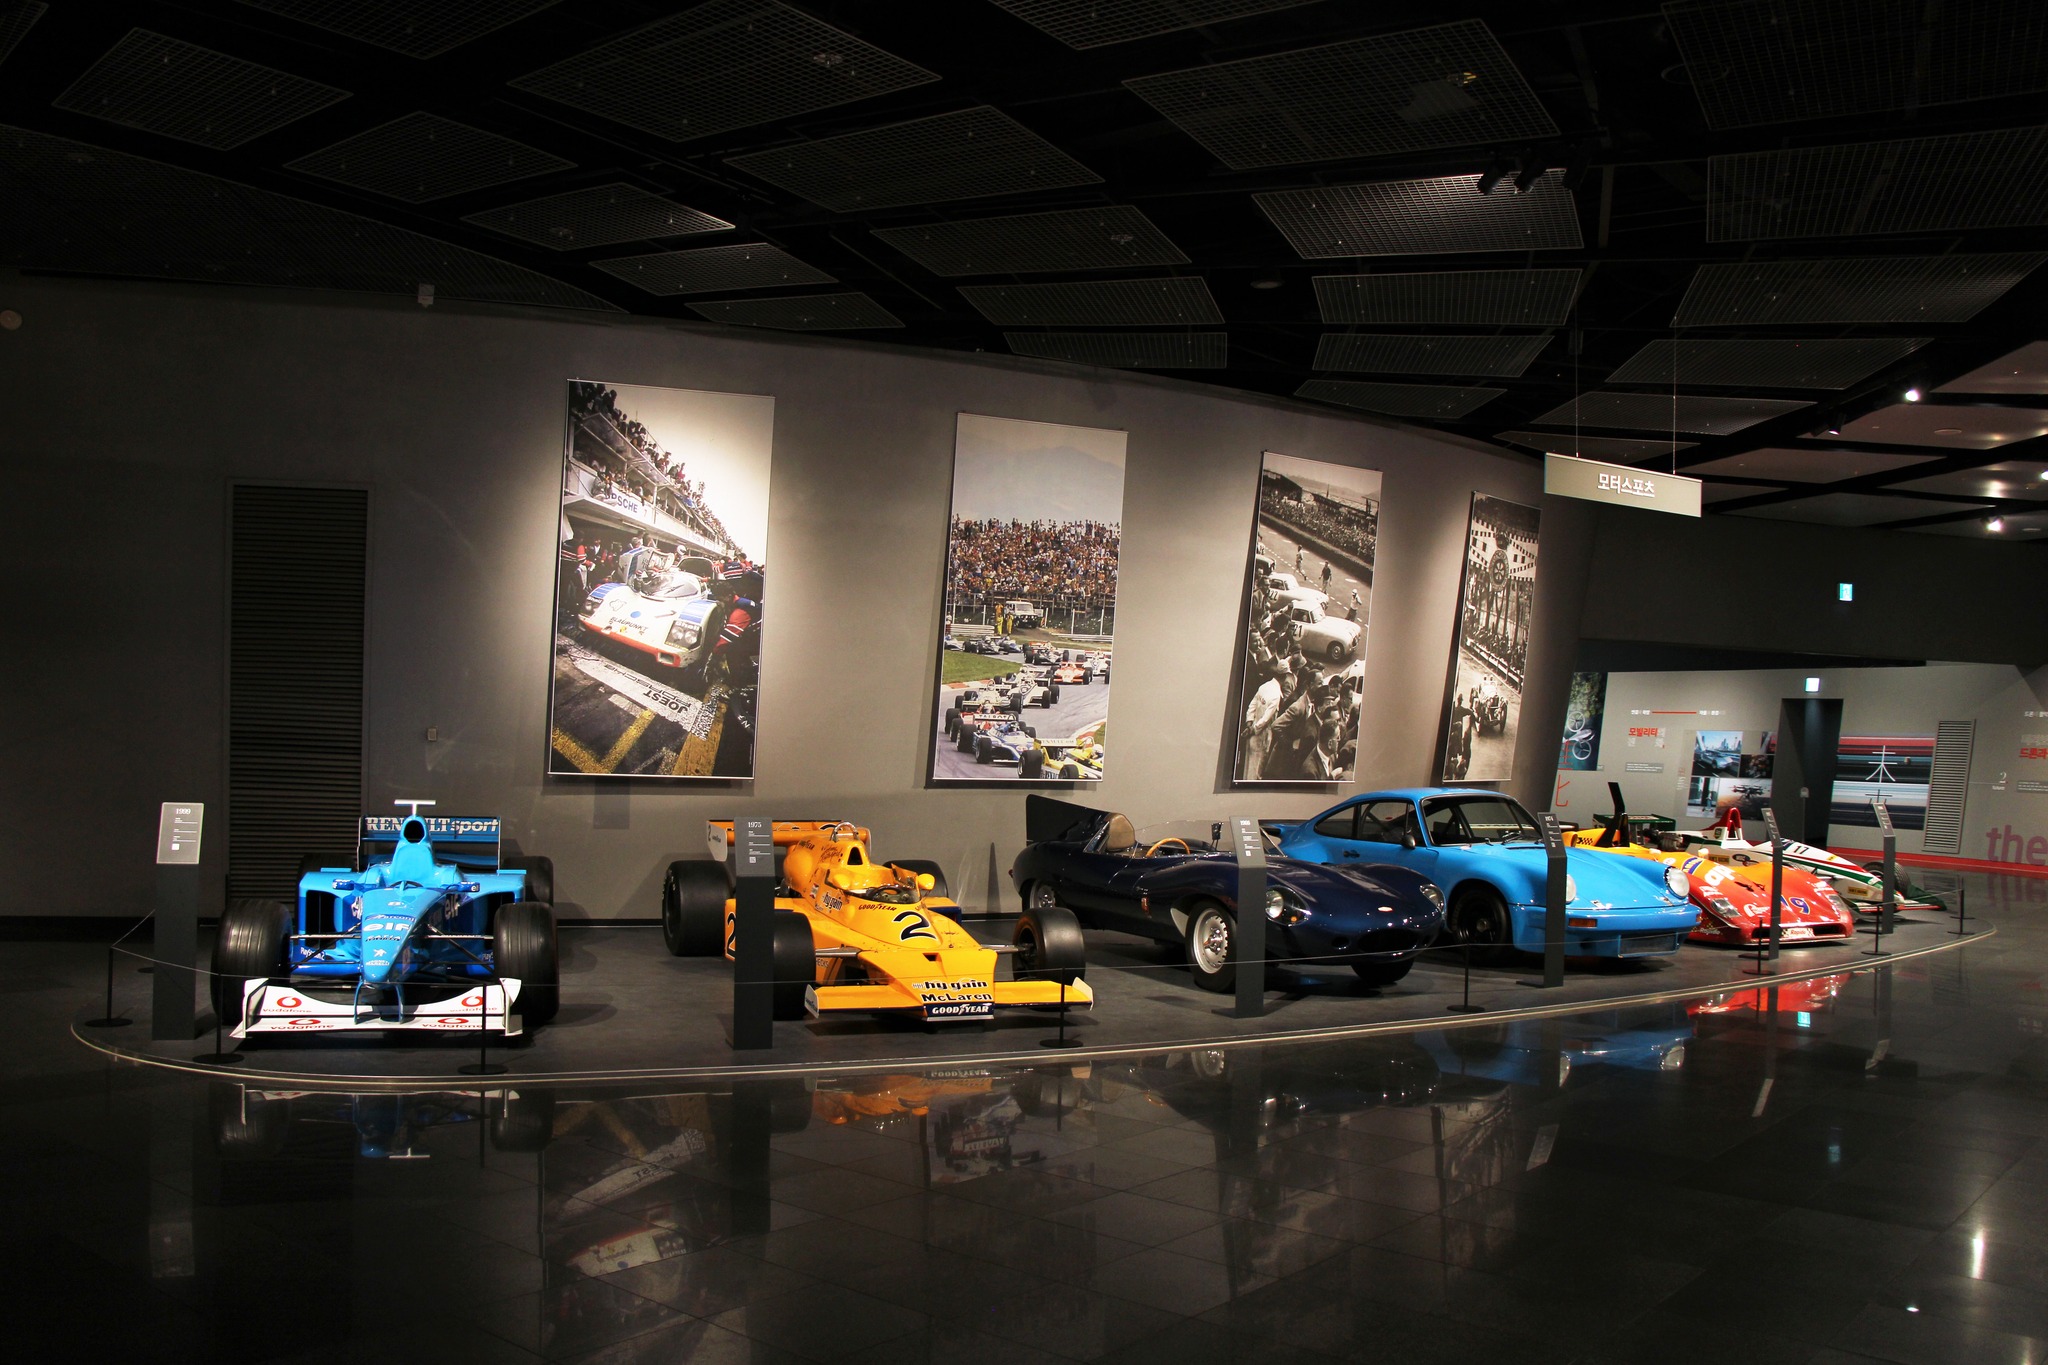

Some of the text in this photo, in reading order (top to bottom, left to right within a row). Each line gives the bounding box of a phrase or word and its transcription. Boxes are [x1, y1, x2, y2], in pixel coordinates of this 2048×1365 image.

[1597, 472, 1656, 498] 모터스포츠
[609, 616, 649, 632] BLAUPUNKT
[643, 690, 689, 714] JOEST
[365, 817, 499, 835] RENLT sport
[1794, 844, 1810, 855] 17
[1986, 824, 2048, 867] the
[858, 903, 897, 911] GOODYEAR
[363, 922, 411, 932] elf
[892, 909, 938, 942] 2
[920, 993, 994, 1003] McLaren
[931, 1004, 990, 1016] GOODYEAR
